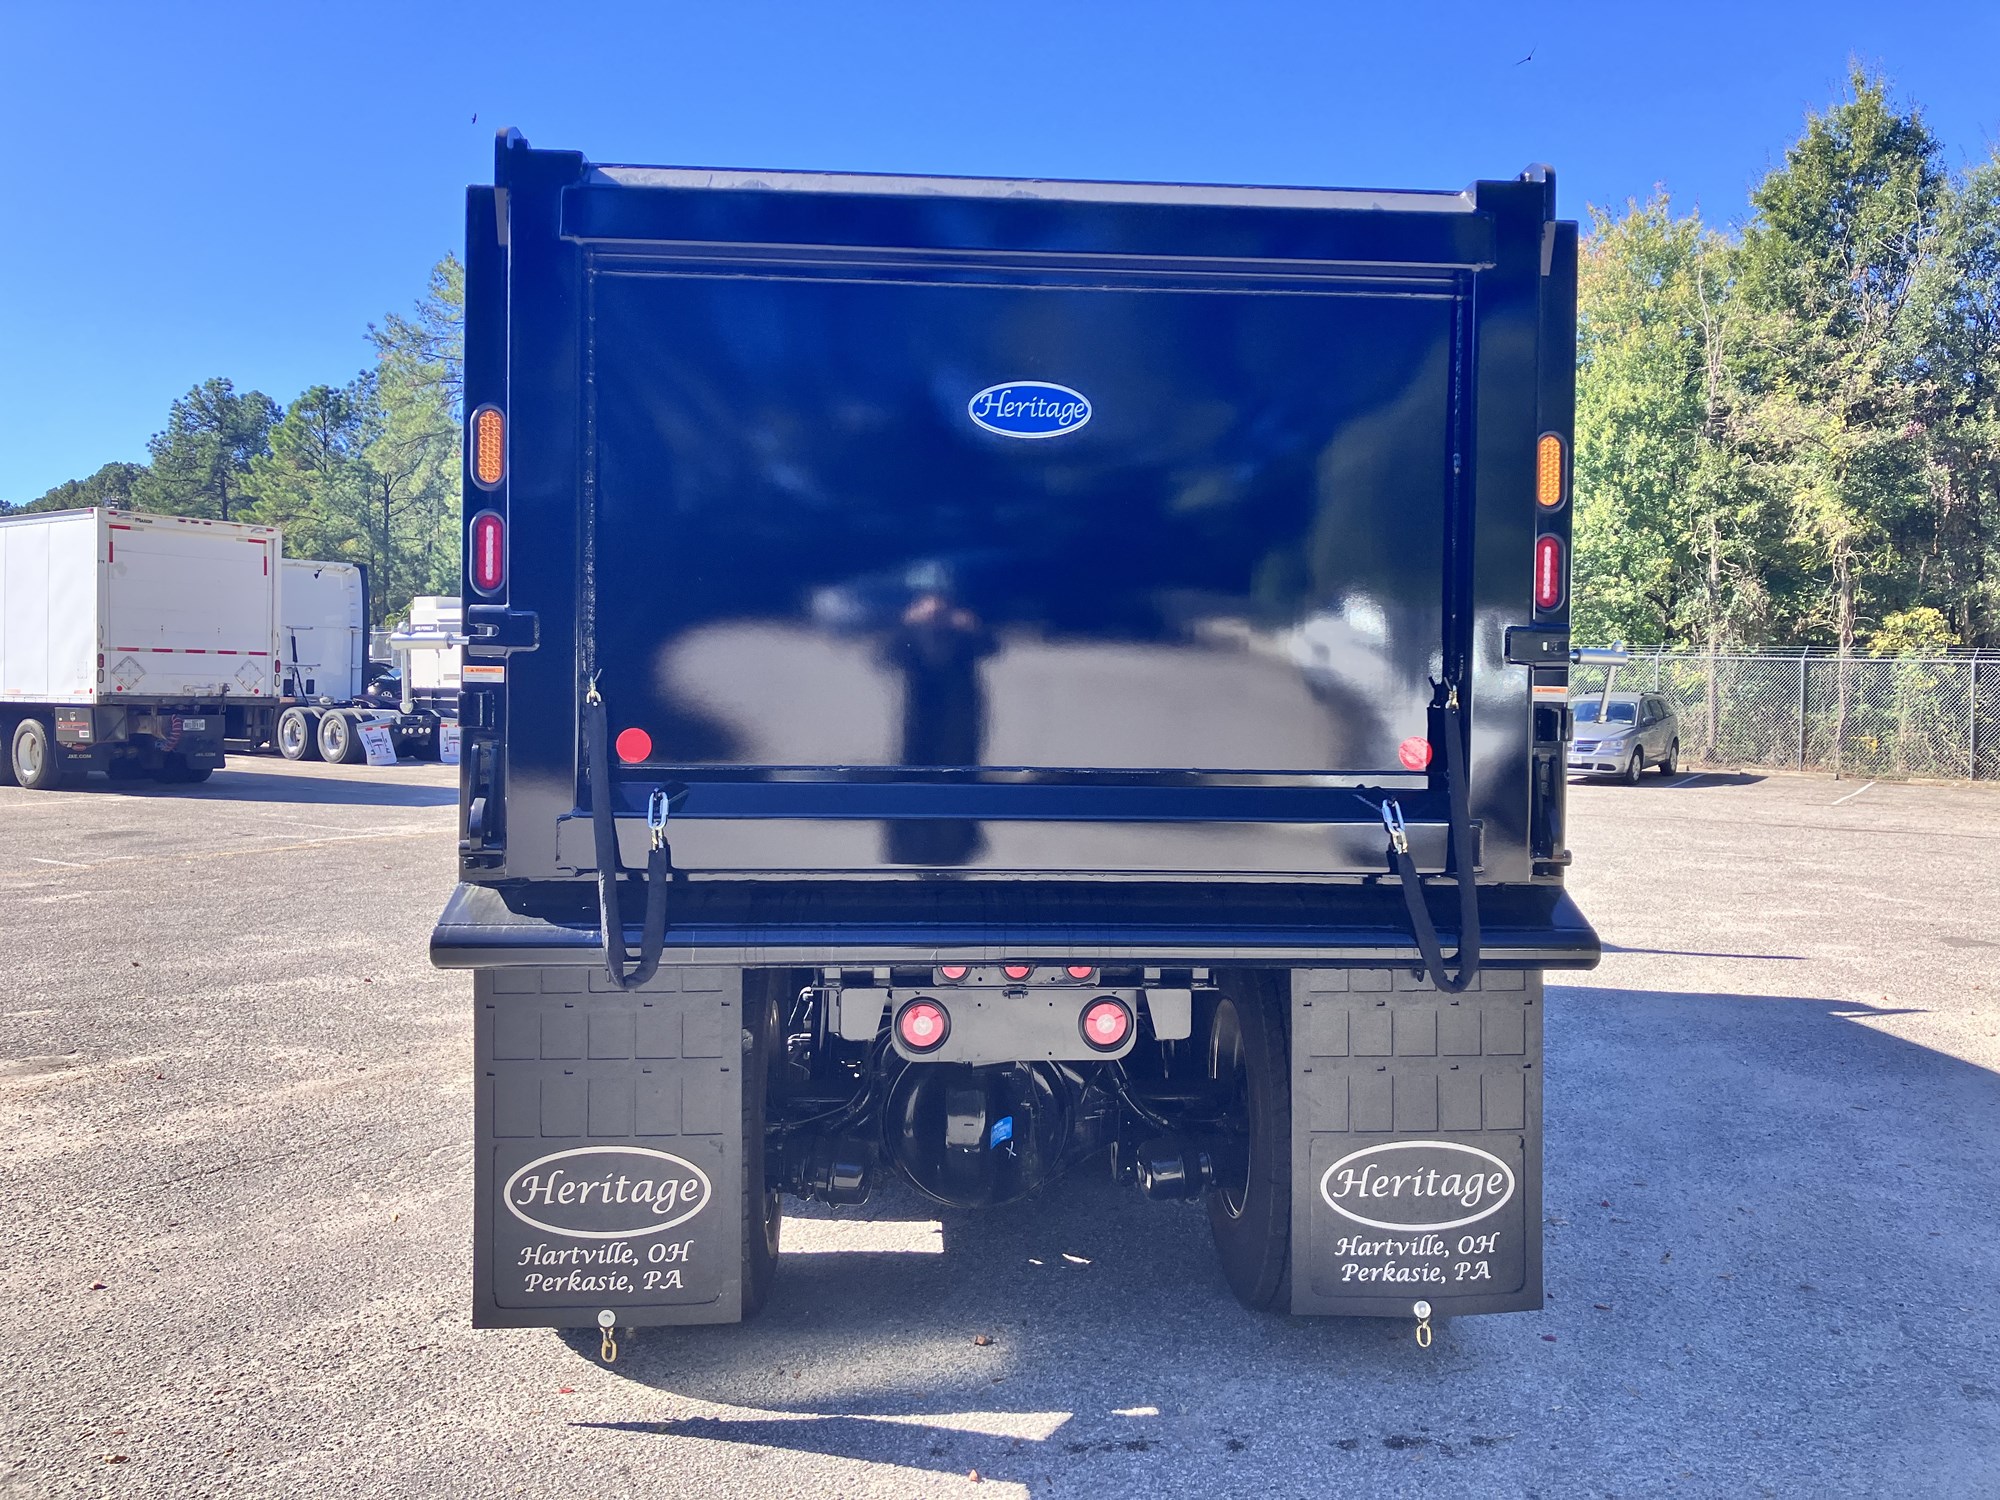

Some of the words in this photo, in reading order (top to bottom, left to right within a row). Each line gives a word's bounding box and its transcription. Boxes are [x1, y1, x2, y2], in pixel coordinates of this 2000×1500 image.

[976, 390, 1086, 426] Heritage
[516, 1169, 699, 1214] Heritage
[1332, 1164, 1504, 1208] Heritage
[517, 1241, 639, 1266] Hartville,
[648, 1240, 695, 1263] OH
[1334, 1233, 1450, 1258] Hartville,
[1457, 1232, 1500, 1255] OH
[524, 1269, 634, 1293] Perkasie,
[643, 1269, 683, 1290] PA
[1341, 1261, 1447, 1284] Perkasie,
[1454, 1260, 1491, 1281] PA
